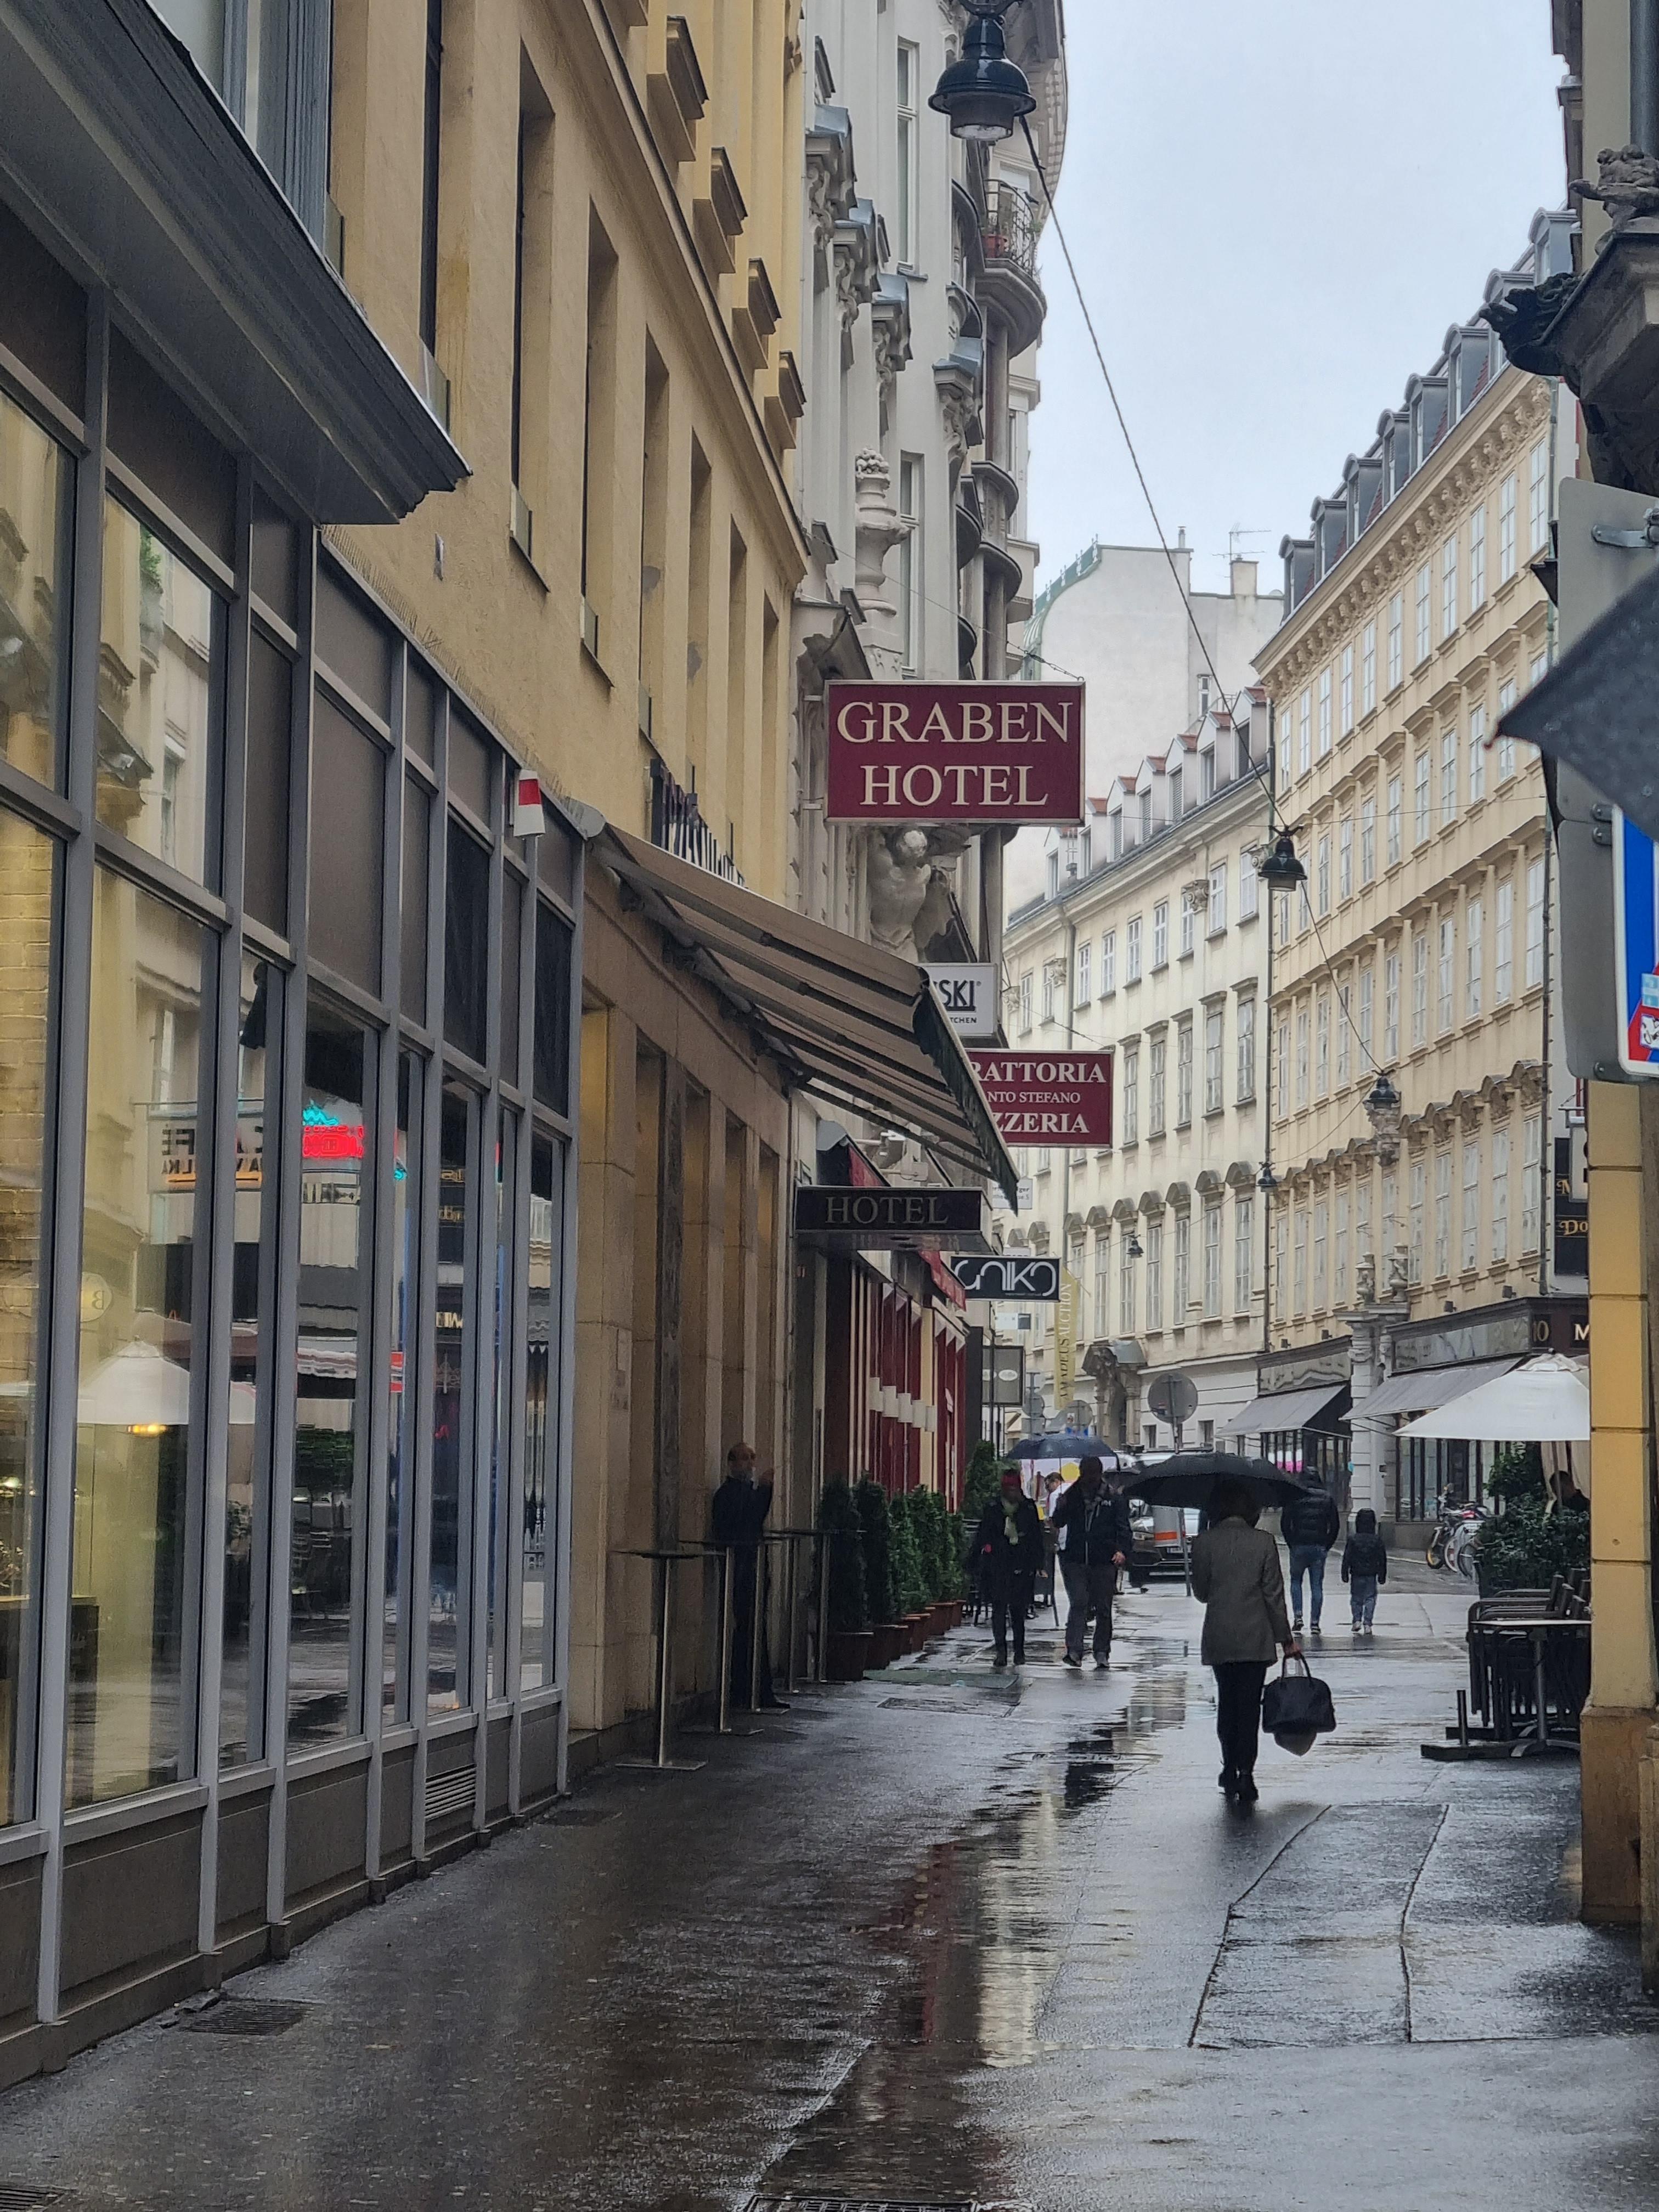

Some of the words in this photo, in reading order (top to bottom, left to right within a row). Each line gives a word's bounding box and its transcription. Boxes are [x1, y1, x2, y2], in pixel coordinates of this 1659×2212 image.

[837, 701, 1073, 743] GRABEN
[859, 764, 1048, 806] HOTEL
[933, 979, 975, 1009] SKI
[1019, 1091, 1081, 1104] STEFANO
[825, 1196, 949, 1224] HOTEL
